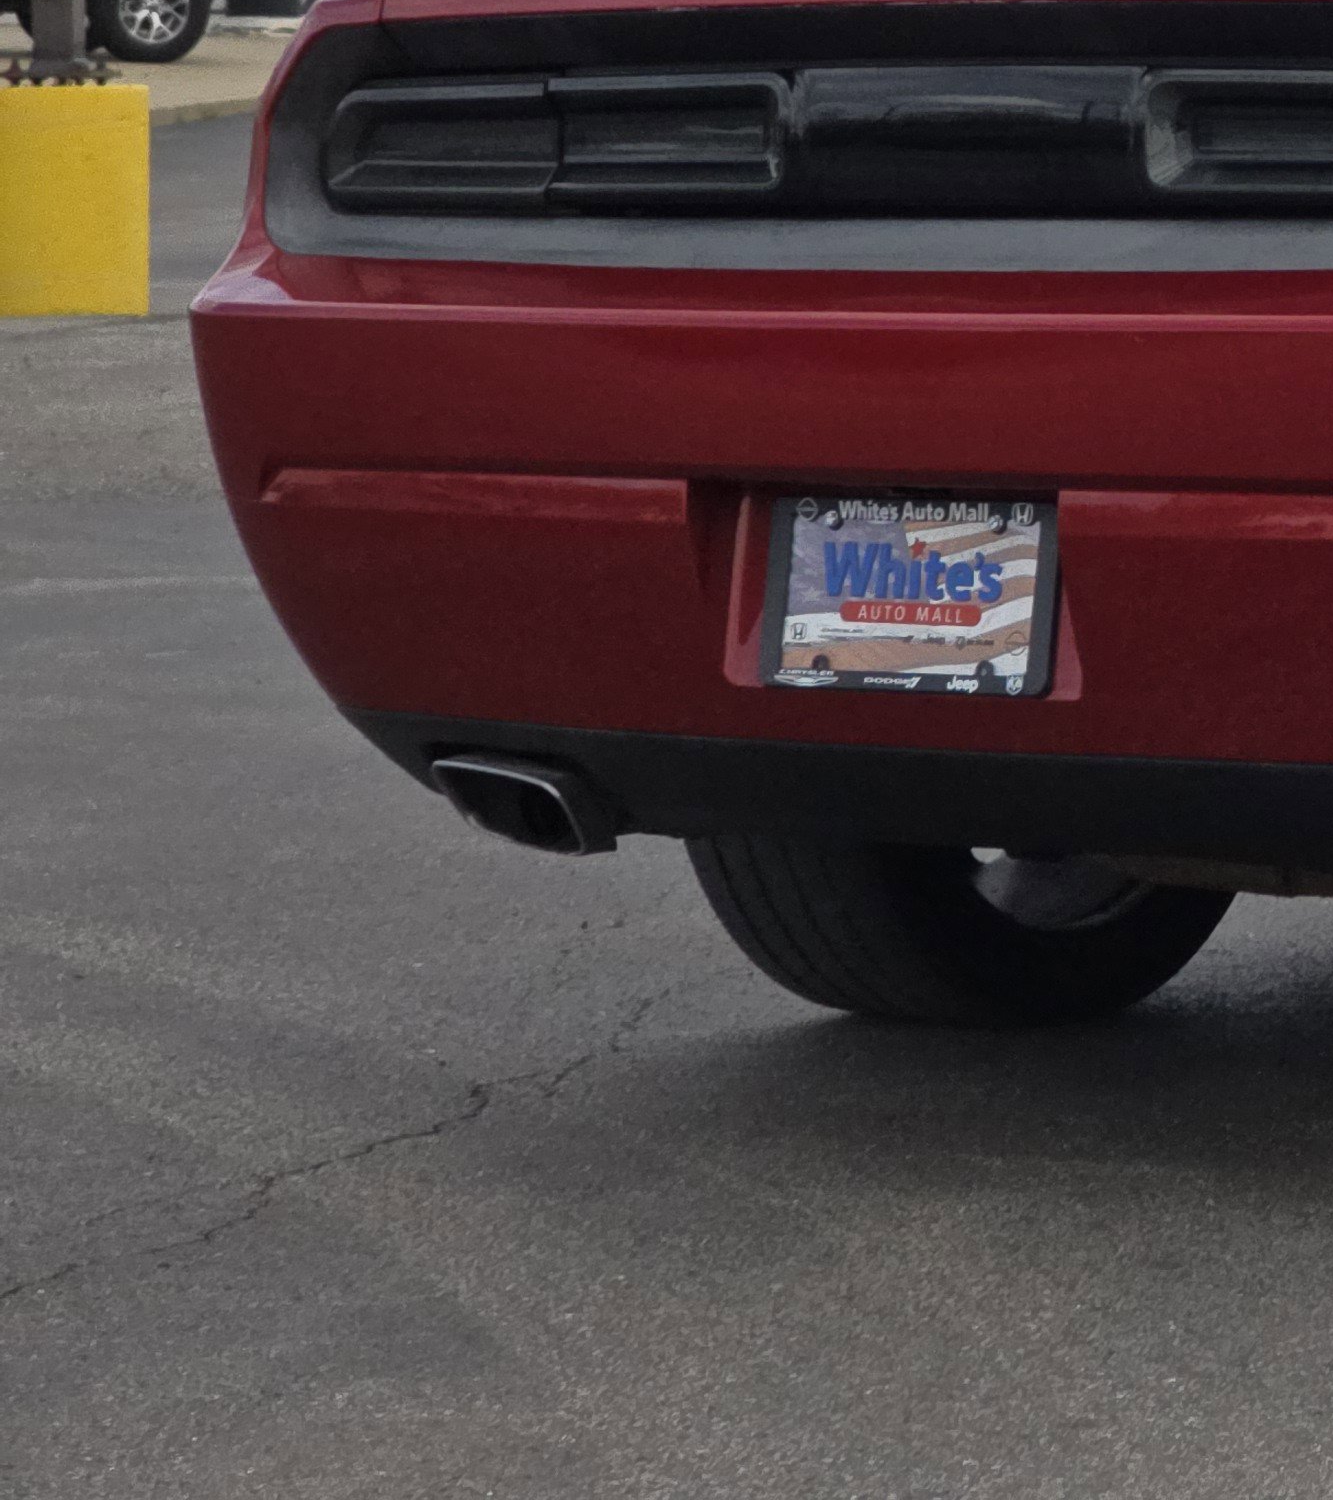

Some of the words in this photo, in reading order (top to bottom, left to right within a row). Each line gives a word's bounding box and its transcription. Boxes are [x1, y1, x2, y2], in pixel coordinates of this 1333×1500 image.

[838, 500, 899, 521] White's
[901, 501, 945, 521] Auto
[948, 502, 989, 522] Mall
[823, 537, 1004, 603] White's
[857, 605, 906, 622] AUTO
[915, 607, 963, 624] MALL
[946, 674, 980, 694] Jeep
